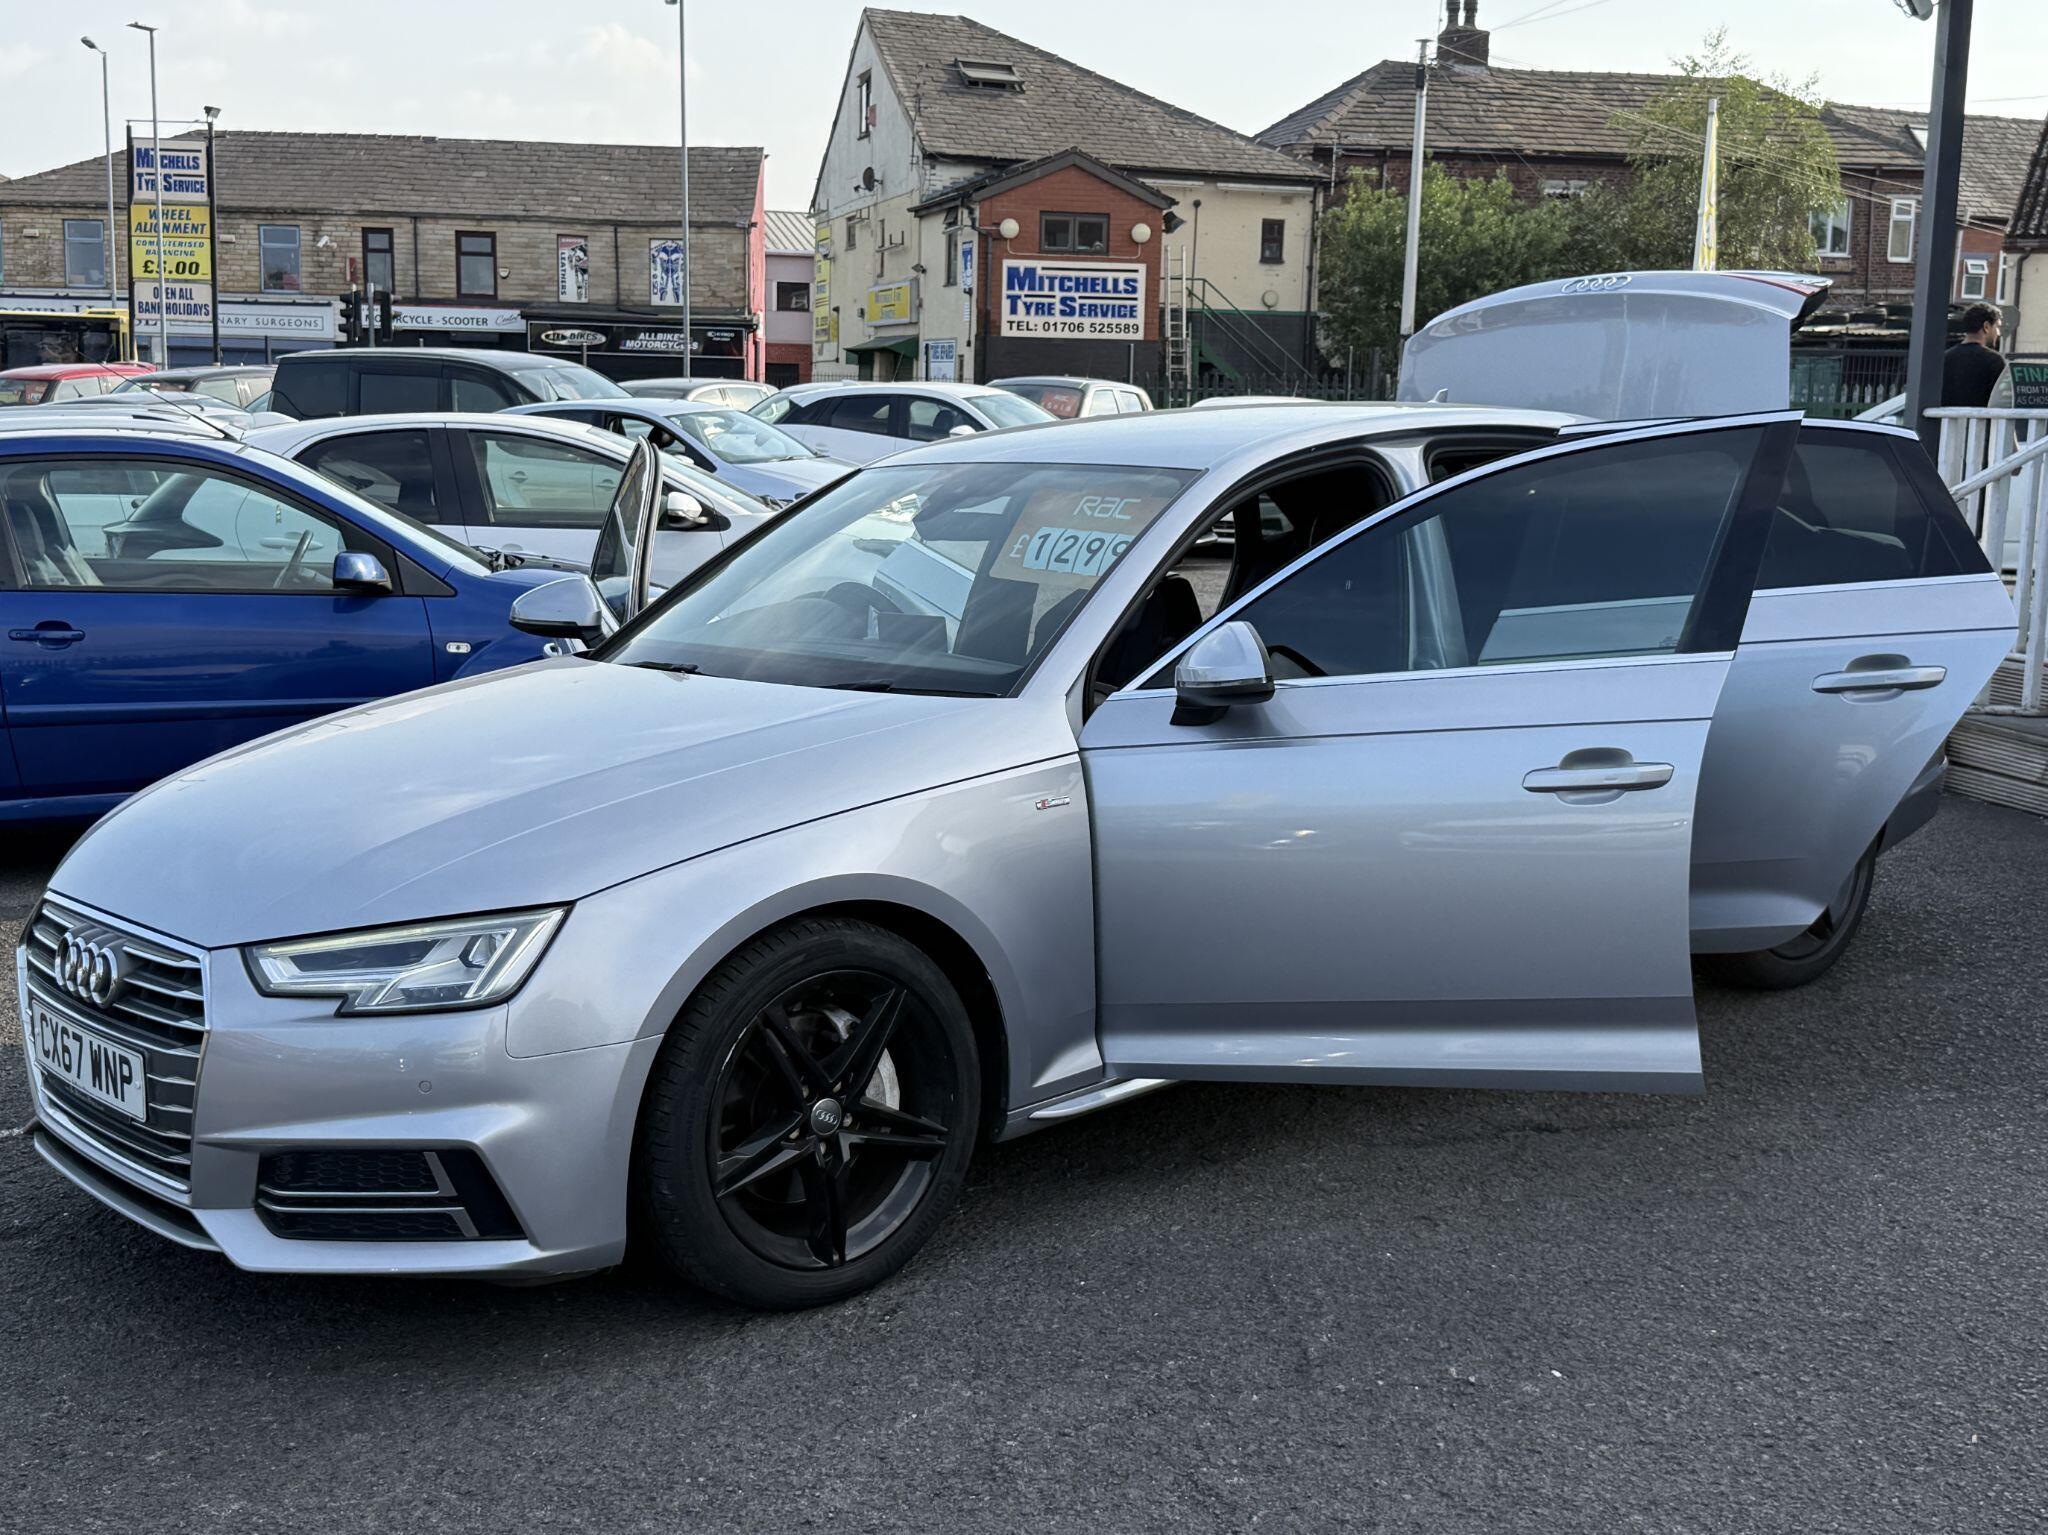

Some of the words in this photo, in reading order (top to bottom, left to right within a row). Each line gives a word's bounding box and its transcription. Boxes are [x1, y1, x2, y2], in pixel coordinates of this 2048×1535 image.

[135, 147, 200, 170] MICHELLS
[136, 172, 162, 191] TYR
[163, 173, 205, 193] SERVICE
[136, 239, 204, 248] COMUTERISED
[1006, 266, 1138, 295] MITCHELLS
[153, 286, 177, 300] OEN
[178, 287, 194, 300] ALL
[165, 302, 210, 317] HOLIDAYS
[1006, 294, 1056, 317] TYRE
[1059, 296, 1138, 318] SERVICE
[255, 317, 319, 328] SURGEONS
[441, 316, 488, 326] SCOOTER
[1007, 320, 1038, 332] TEL:
[1042, 321, 1085, 333] 01706
[1089, 322, 1139, 335] 525589
[40, 1012, 83, 1080] CX67
[89, 1039, 133, 1102] WNP
